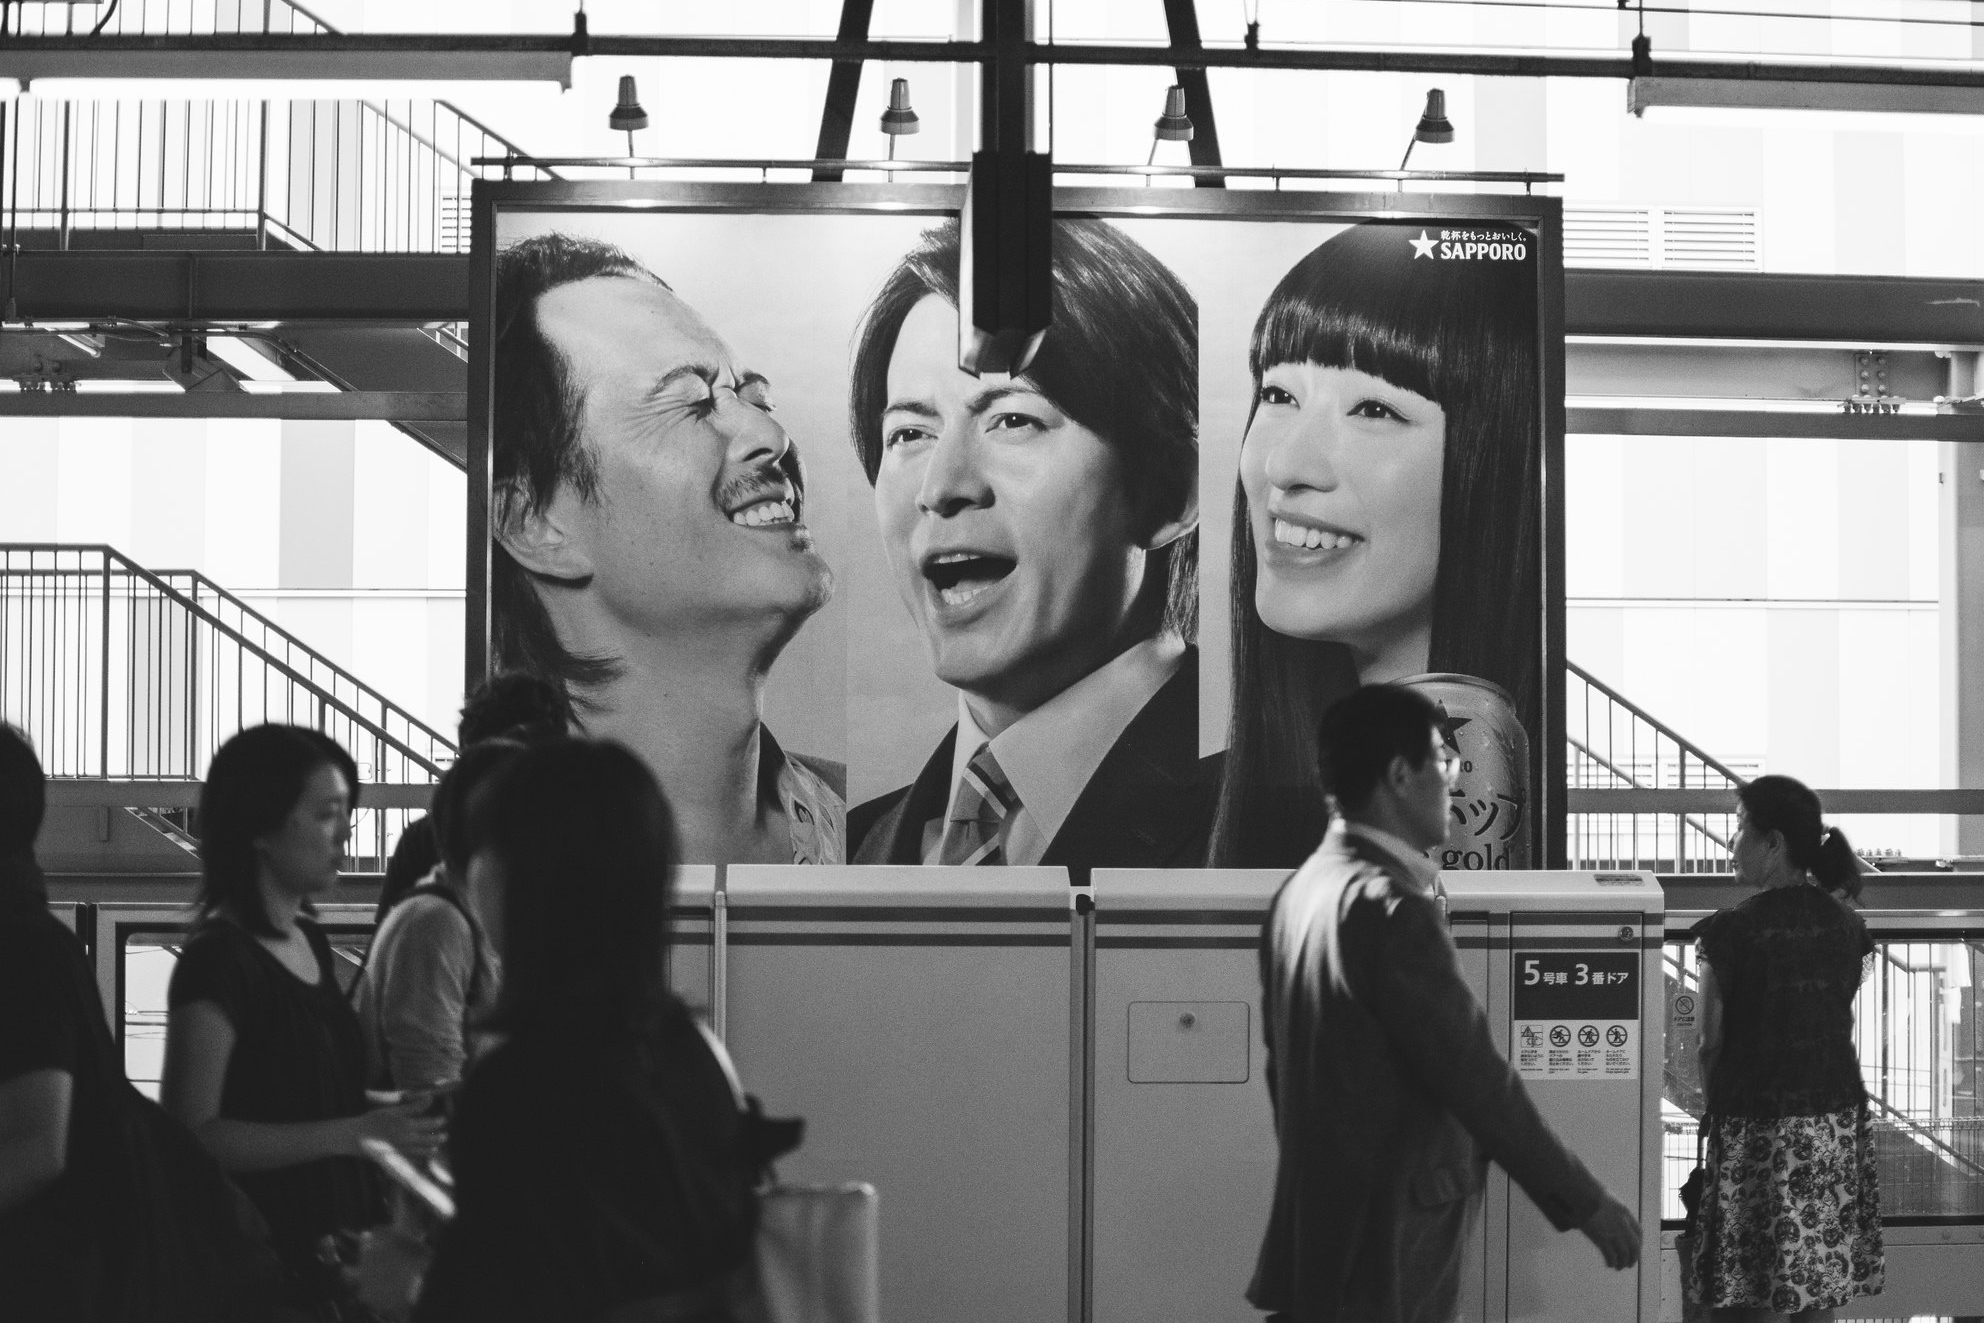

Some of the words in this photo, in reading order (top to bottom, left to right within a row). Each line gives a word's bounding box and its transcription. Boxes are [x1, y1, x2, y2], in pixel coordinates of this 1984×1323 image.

[1440, 229, 1527, 241] 乾杯をもっとおいしく。
[1440, 242, 1526, 260] SAPPORO
[1441, 844, 1510, 870] gold
